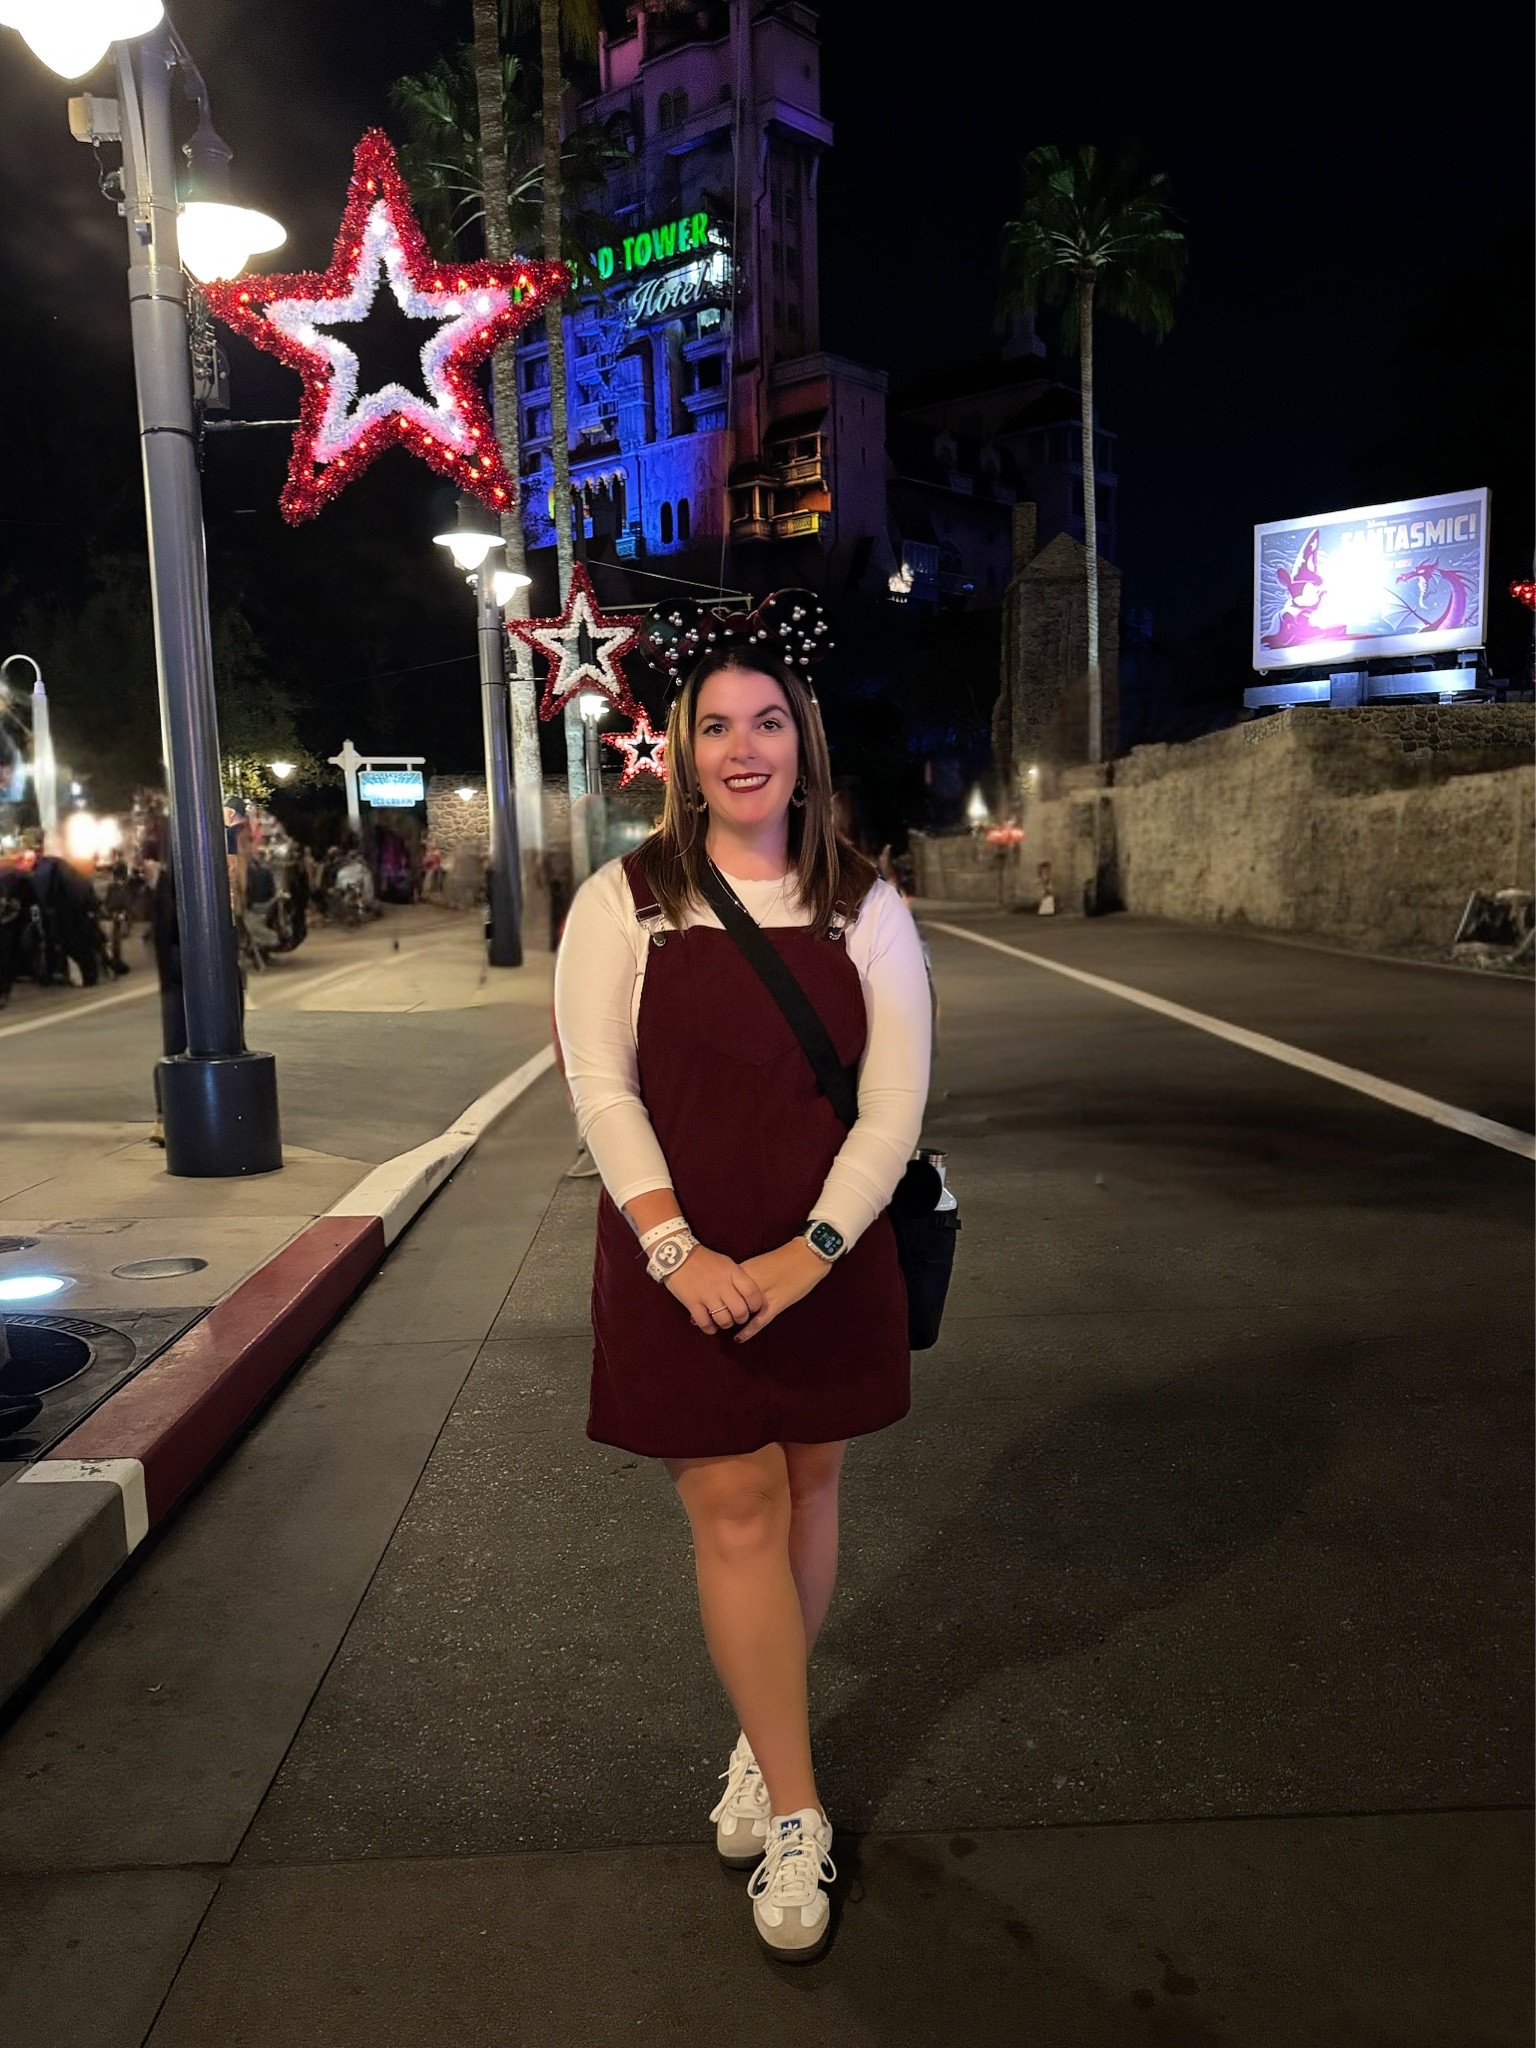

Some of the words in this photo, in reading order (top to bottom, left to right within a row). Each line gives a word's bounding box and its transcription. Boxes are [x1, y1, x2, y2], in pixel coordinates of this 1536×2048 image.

[622, 211, 708, 271] TOWER
[628, 262, 708, 321] Hotel
[1341, 514, 1476, 554] FANTASMIC!
